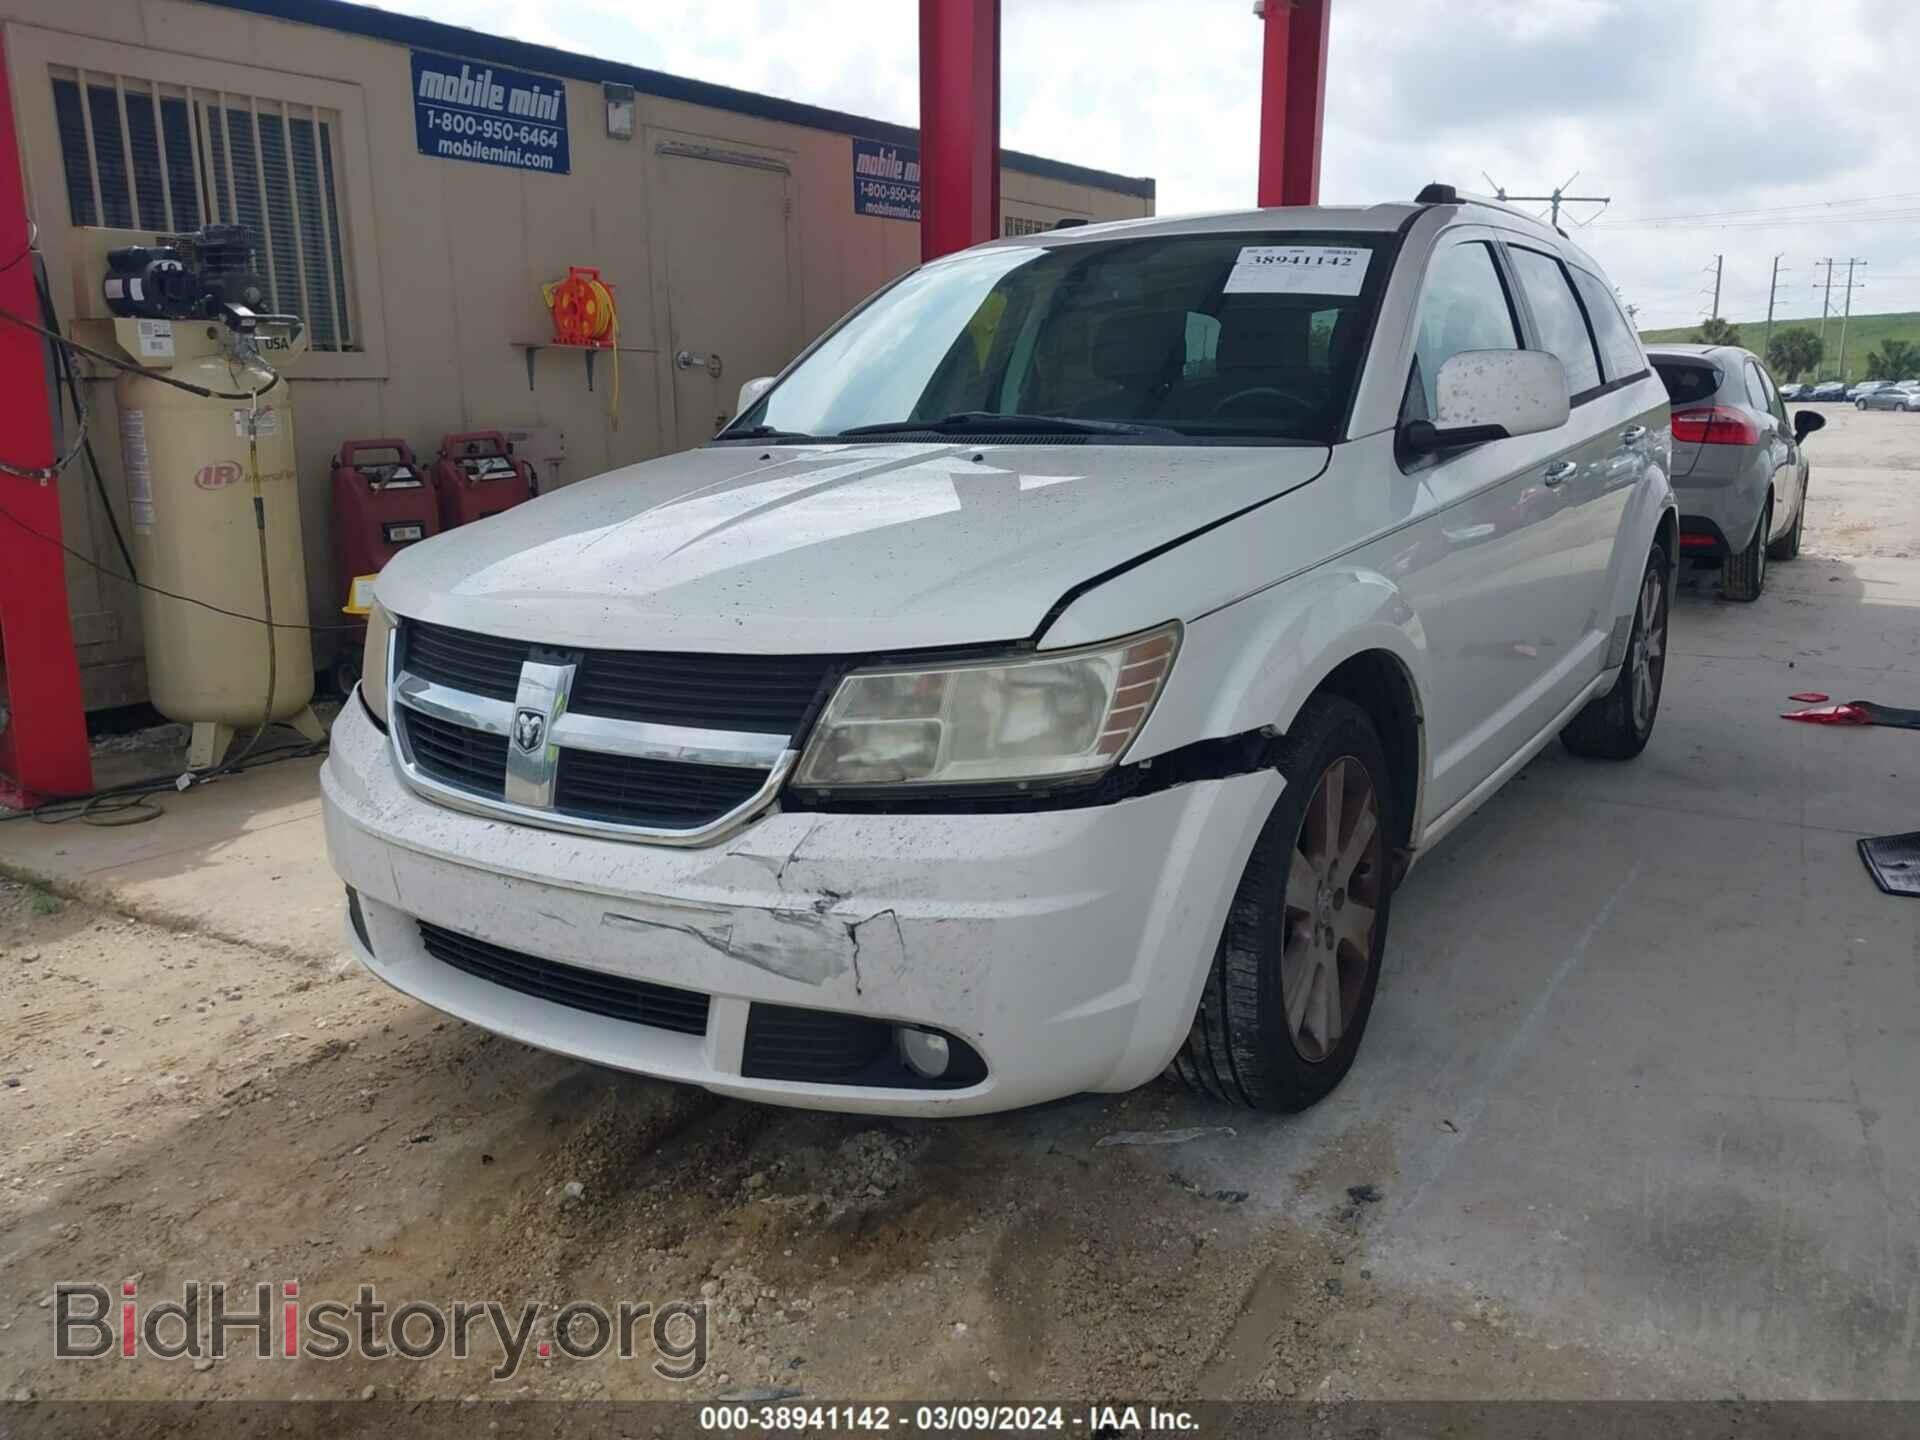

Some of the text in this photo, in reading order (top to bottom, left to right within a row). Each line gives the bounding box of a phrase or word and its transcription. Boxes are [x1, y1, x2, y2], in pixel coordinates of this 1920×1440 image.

[418, 64, 562, 121] mobile mini
[426, 109, 558, 149] 1-800-950-6464
[437, 139, 553, 169] mobilemini.com
[856, 146, 904, 180] mobile
[1250, 255, 1352, 267] 38941142
[265, 336, 290, 351] USA
